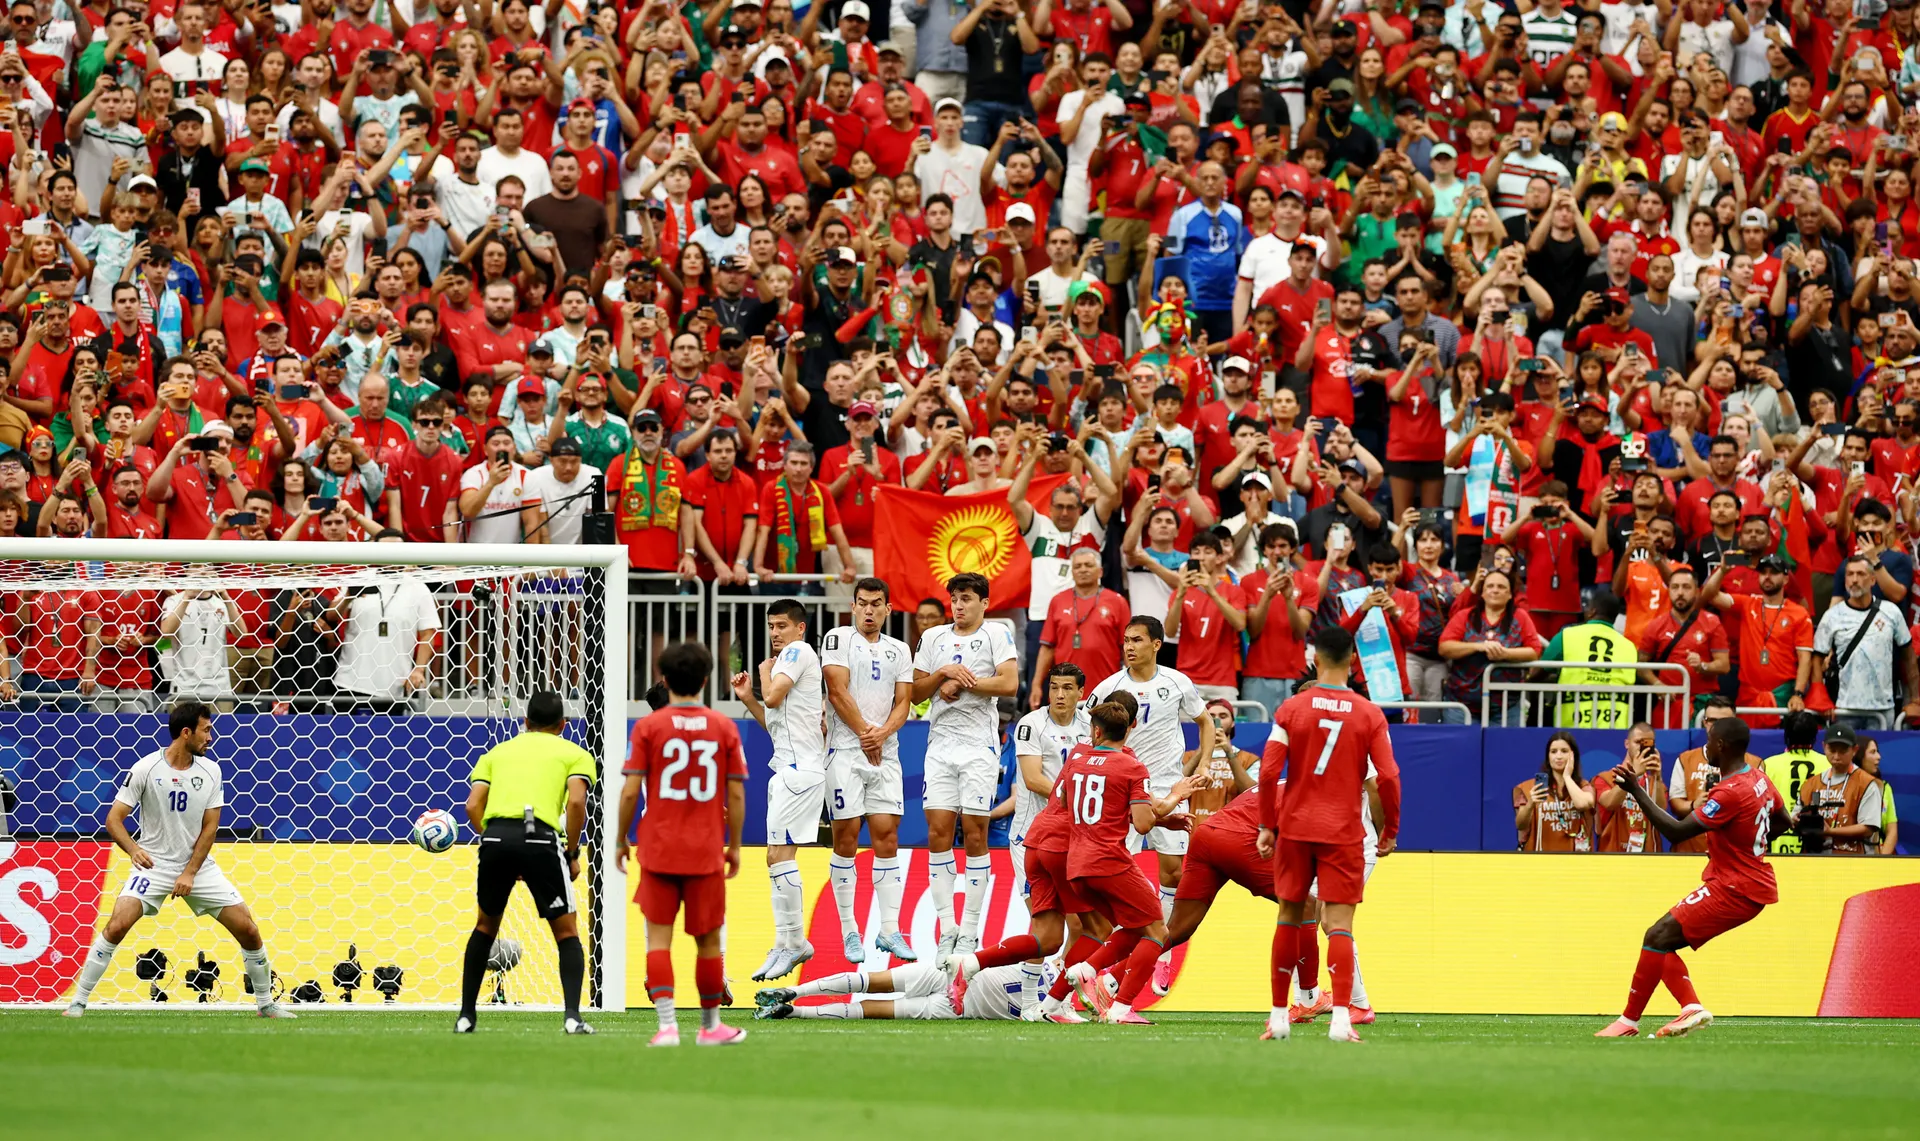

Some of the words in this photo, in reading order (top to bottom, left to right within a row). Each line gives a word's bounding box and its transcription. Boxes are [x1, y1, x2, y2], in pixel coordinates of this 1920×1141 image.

[1131, 158, 1139, 176] 7
[269, 173, 279, 195] 7
[310, 326, 320, 345] 7
[1411, 395, 1420, 415] 7
[1281, 456, 1291, 474] 7
[1891, 472, 1903, 494] 7
[420, 485, 431, 508] 7
[1649, 589, 1661, 610] 2
[200, 628, 208, 645] 7
[1200, 617, 1211, 638] 7
[871, 660, 881, 681] 5
[1140, 703, 1151, 724] 7
[1311, 696, 1353, 713] RONALDO
[1314, 718, 1344, 776] 7
[659, 738, 720, 802] 23
[1086, 755, 1107, 766] NETO
[168, 790, 188, 813] 18
[834, 788, 845, 810] 5
[1070, 772, 1107, 825] 18
[130, 875, 151, 896] 18
